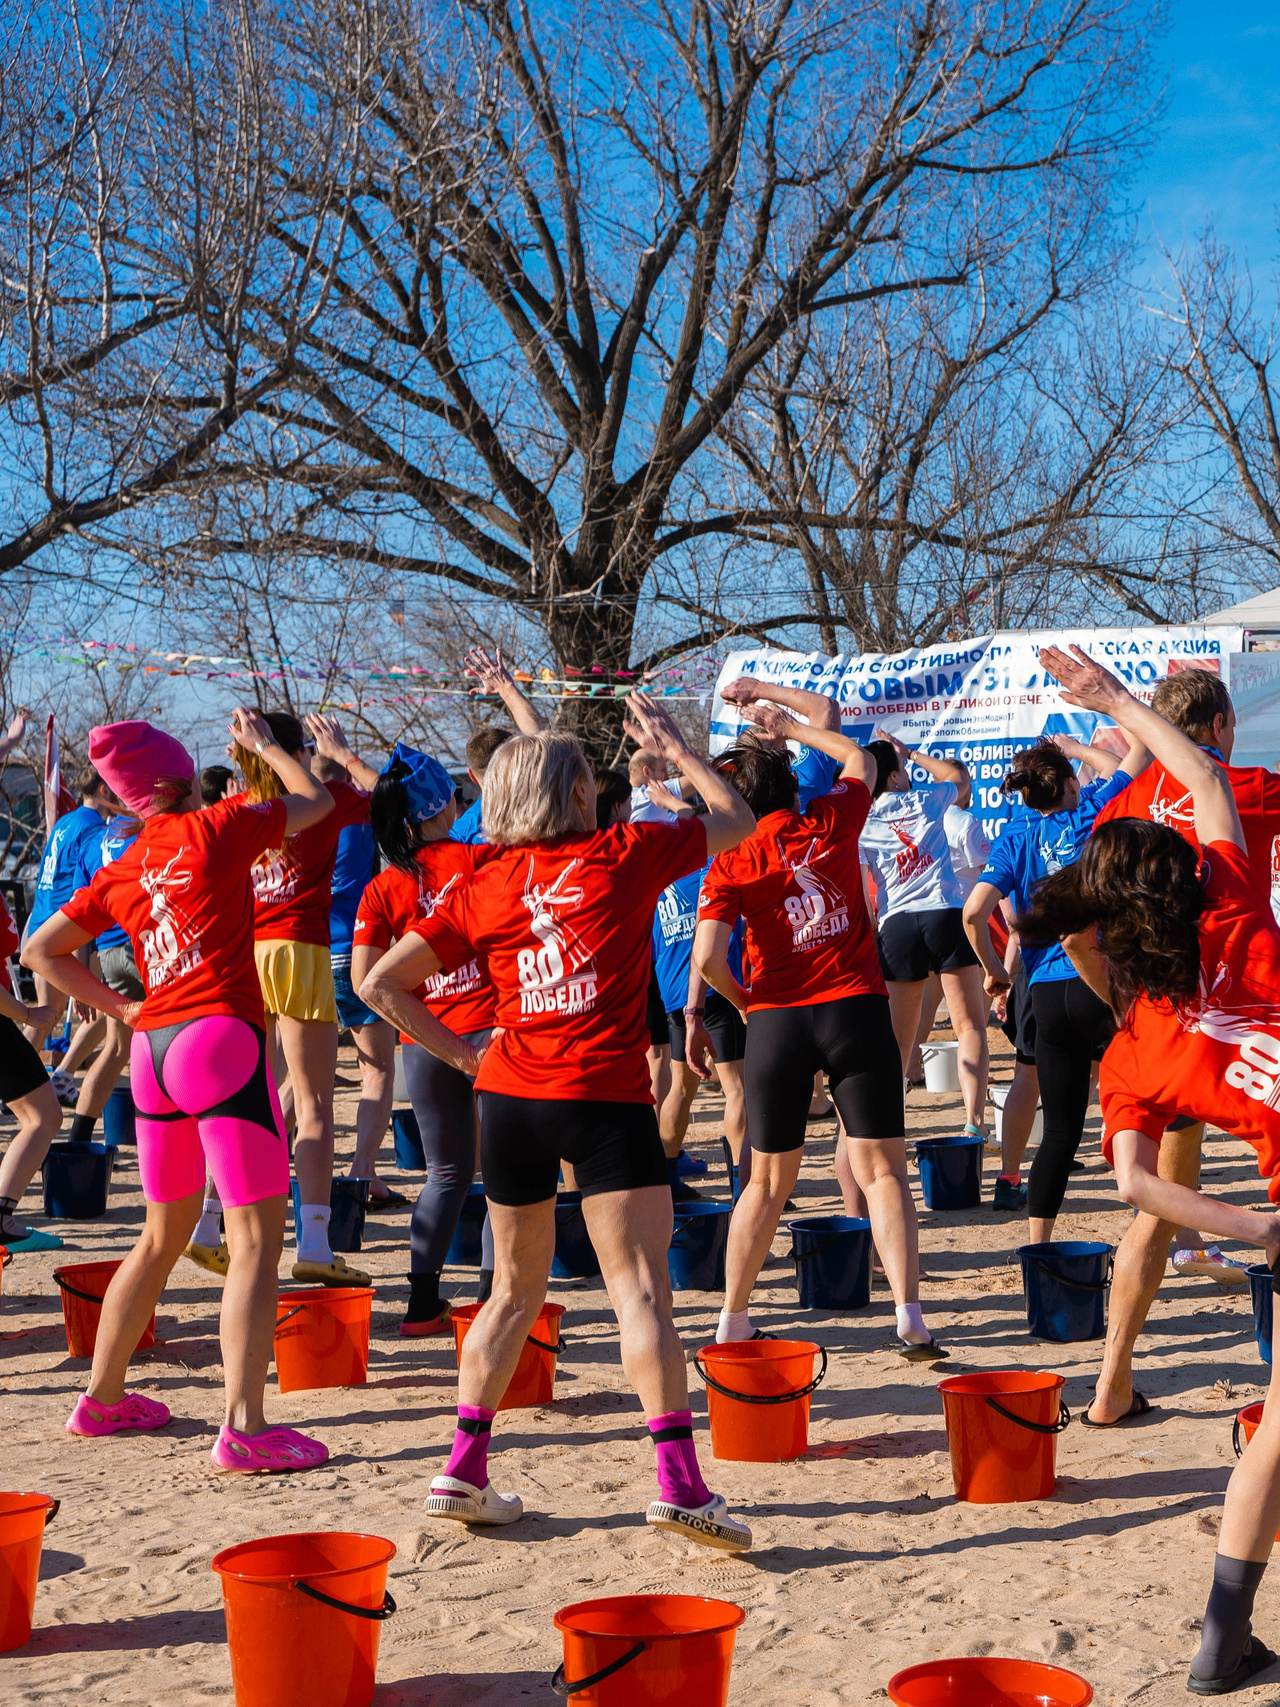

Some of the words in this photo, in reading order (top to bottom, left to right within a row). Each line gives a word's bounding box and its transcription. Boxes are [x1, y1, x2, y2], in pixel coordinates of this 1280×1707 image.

[1157, 639, 1221, 655] АКЦИЯ
[866, 701, 928, 715] ПОБЕДЫ
[931, 701, 941, 711] В
[978, 786, 1003, 808] 10
[657, 895, 679, 923] 80
[785, 892, 826, 926] 80
[793, 914, 850, 946] ПОБЕДА
[139, 929, 178, 963] 80
[517, 946, 564, 989] 80
[520, 980, 598, 1015] ПОБЕДА
[678, 1512, 719, 1536] crocs
